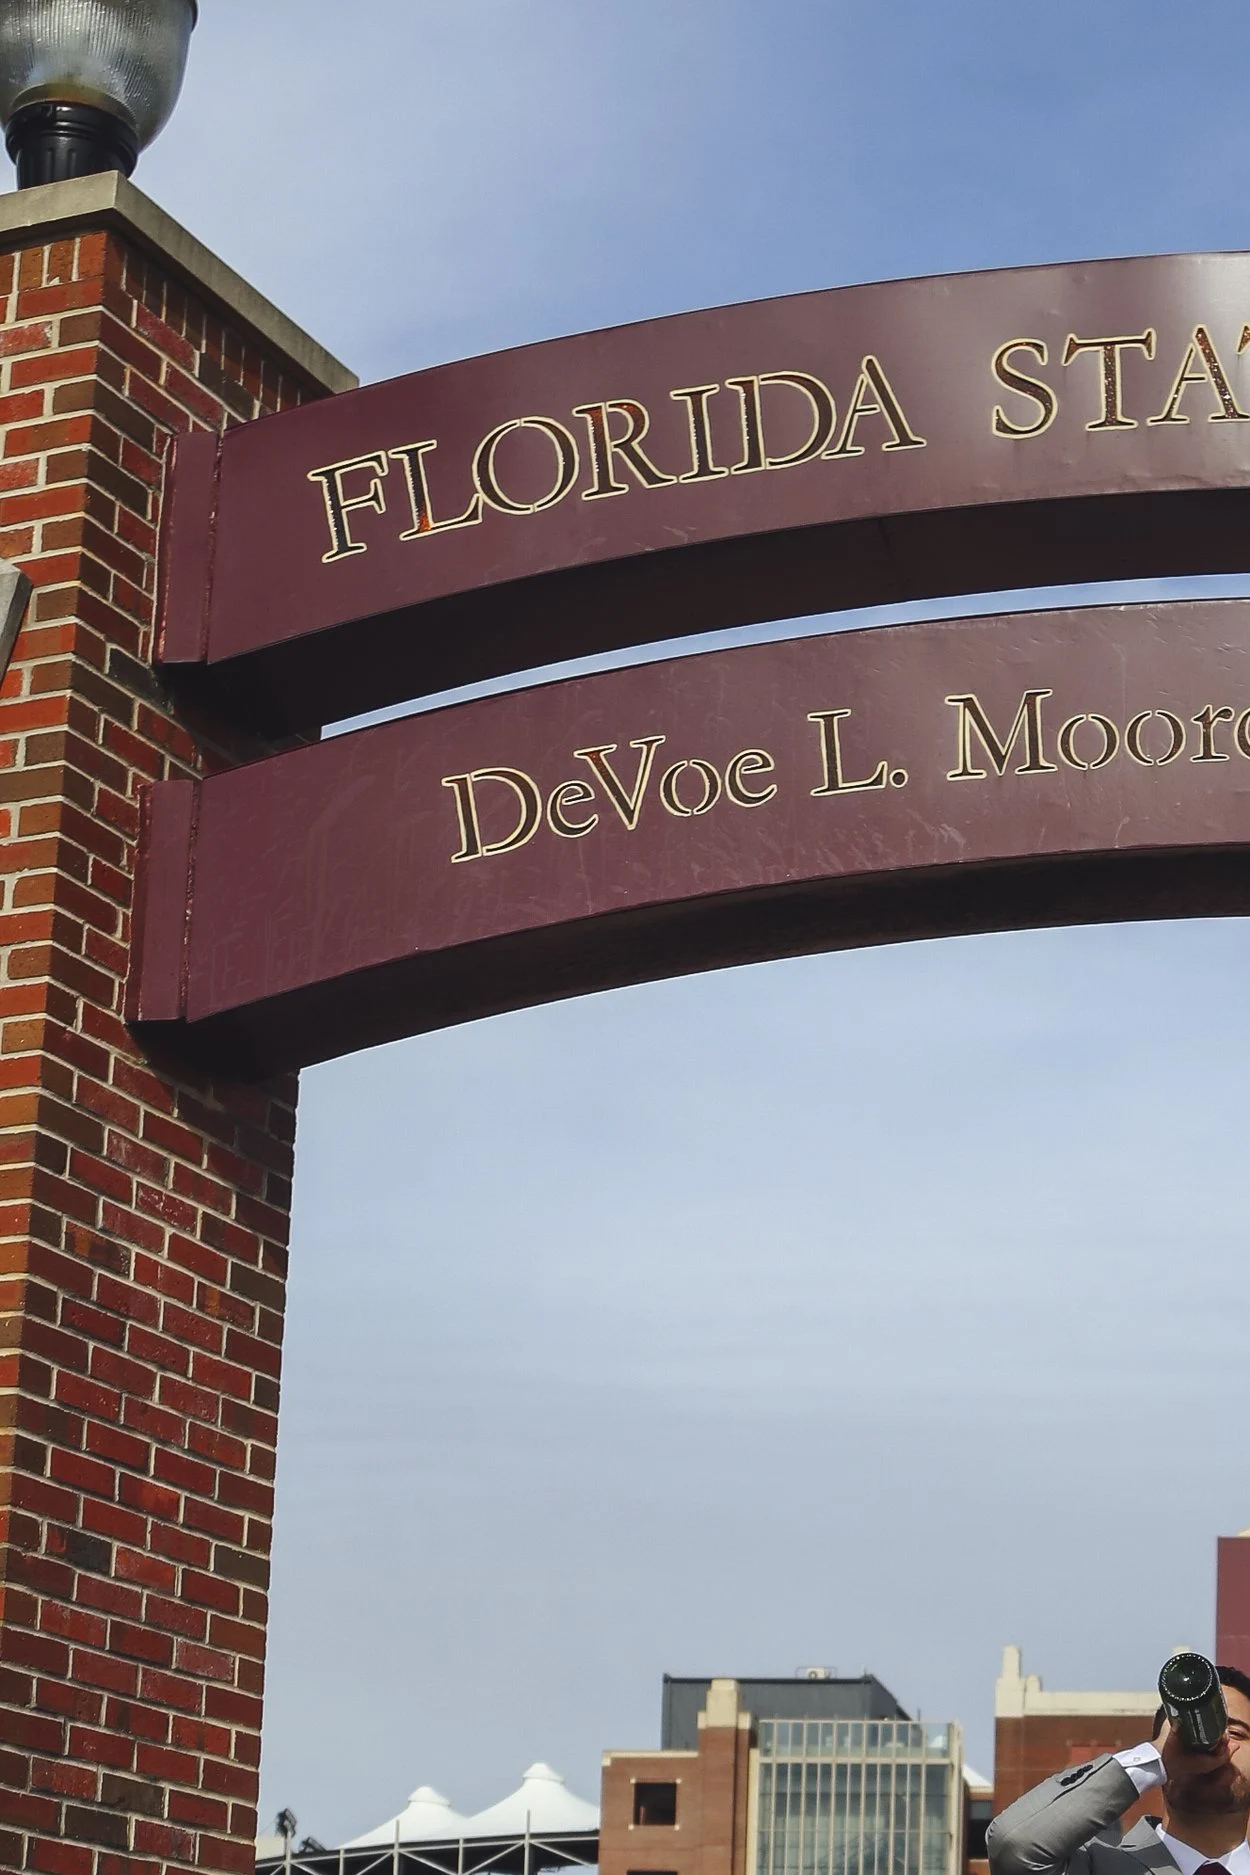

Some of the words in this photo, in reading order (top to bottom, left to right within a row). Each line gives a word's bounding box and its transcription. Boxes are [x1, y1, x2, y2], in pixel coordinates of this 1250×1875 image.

[307, 354, 928, 564] FLORIDA
[441, 734, 778, 863] DeVoe
[806, 707, 909, 797] L.
